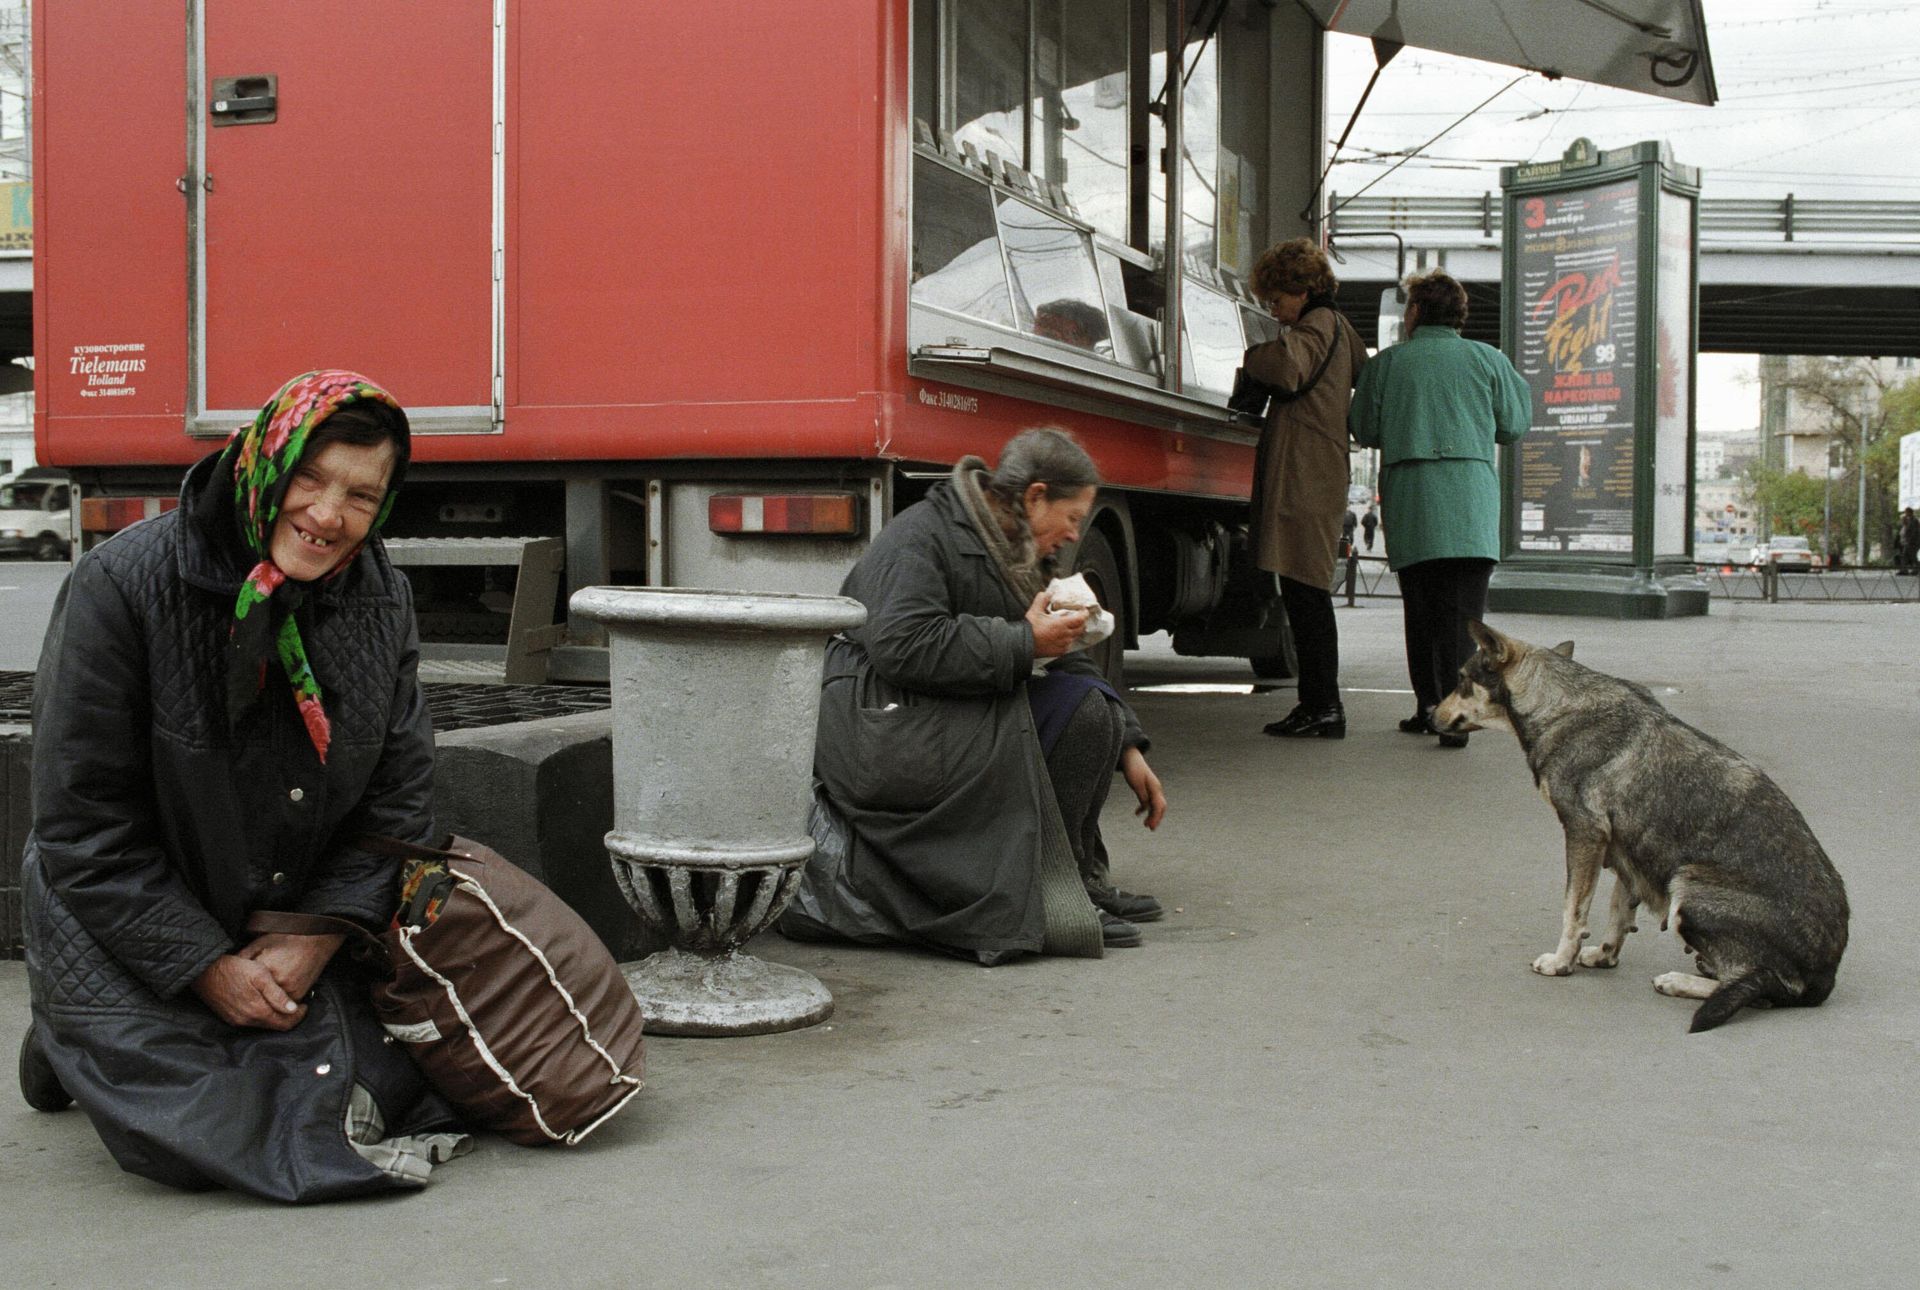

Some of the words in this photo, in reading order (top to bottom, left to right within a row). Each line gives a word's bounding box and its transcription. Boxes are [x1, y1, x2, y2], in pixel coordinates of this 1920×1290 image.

[1525, 197, 1546, 229] 3
[1544, 292, 1613, 376] Fight
[74, 343, 145, 356] кузовостроение
[1596, 343, 1616, 363] 98
[70, 356, 147, 374] Tielemans
[88, 373, 126, 386] Holland
[919, 388, 938, 406] Факс
